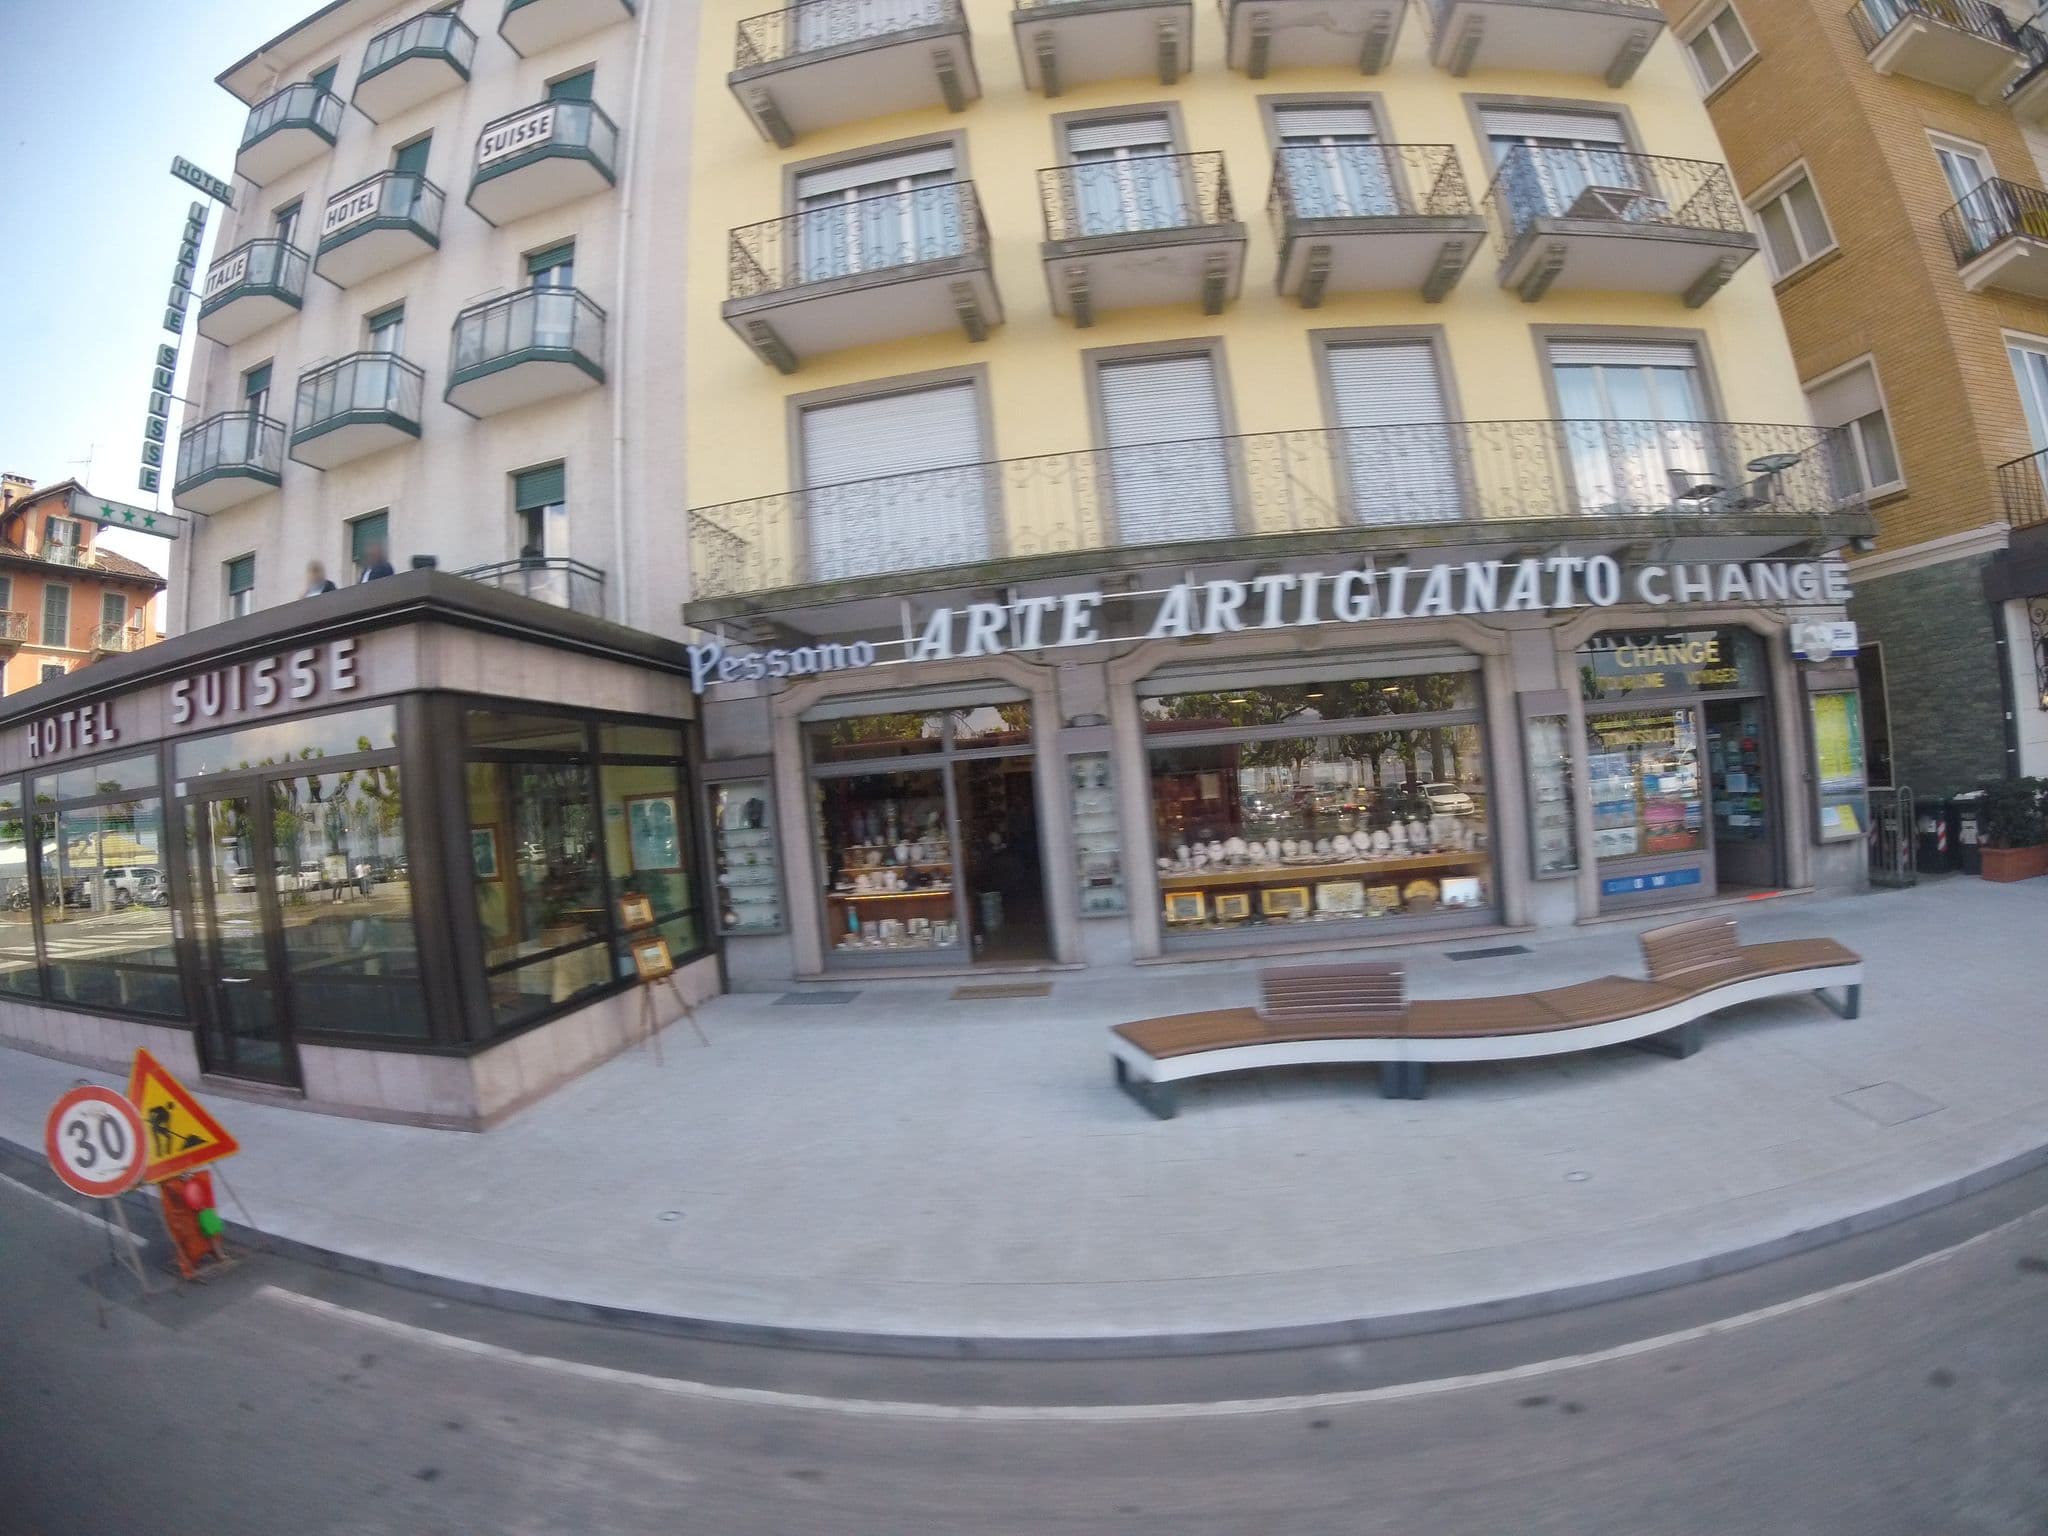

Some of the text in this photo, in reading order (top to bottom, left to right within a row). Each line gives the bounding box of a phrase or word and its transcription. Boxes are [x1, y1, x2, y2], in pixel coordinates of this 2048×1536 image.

[483, 114, 550, 156] SUISSE
[176, 159, 232, 200] HOTEL
[326, 191, 375, 227] HOTEL
[205, 258, 246, 293] ITALIE
[143, 203, 205, 491] ITALIE SUISSE
[1636, 560, 1853, 605] CHANGE
[907, 555, 1620, 662] ARTE ARTIGIANATO
[1614, 640, 1721, 668] CHANGE
[27, 639, 357, 758] HOTEL SUISSE
[66, 1112, 126, 1169] 30
